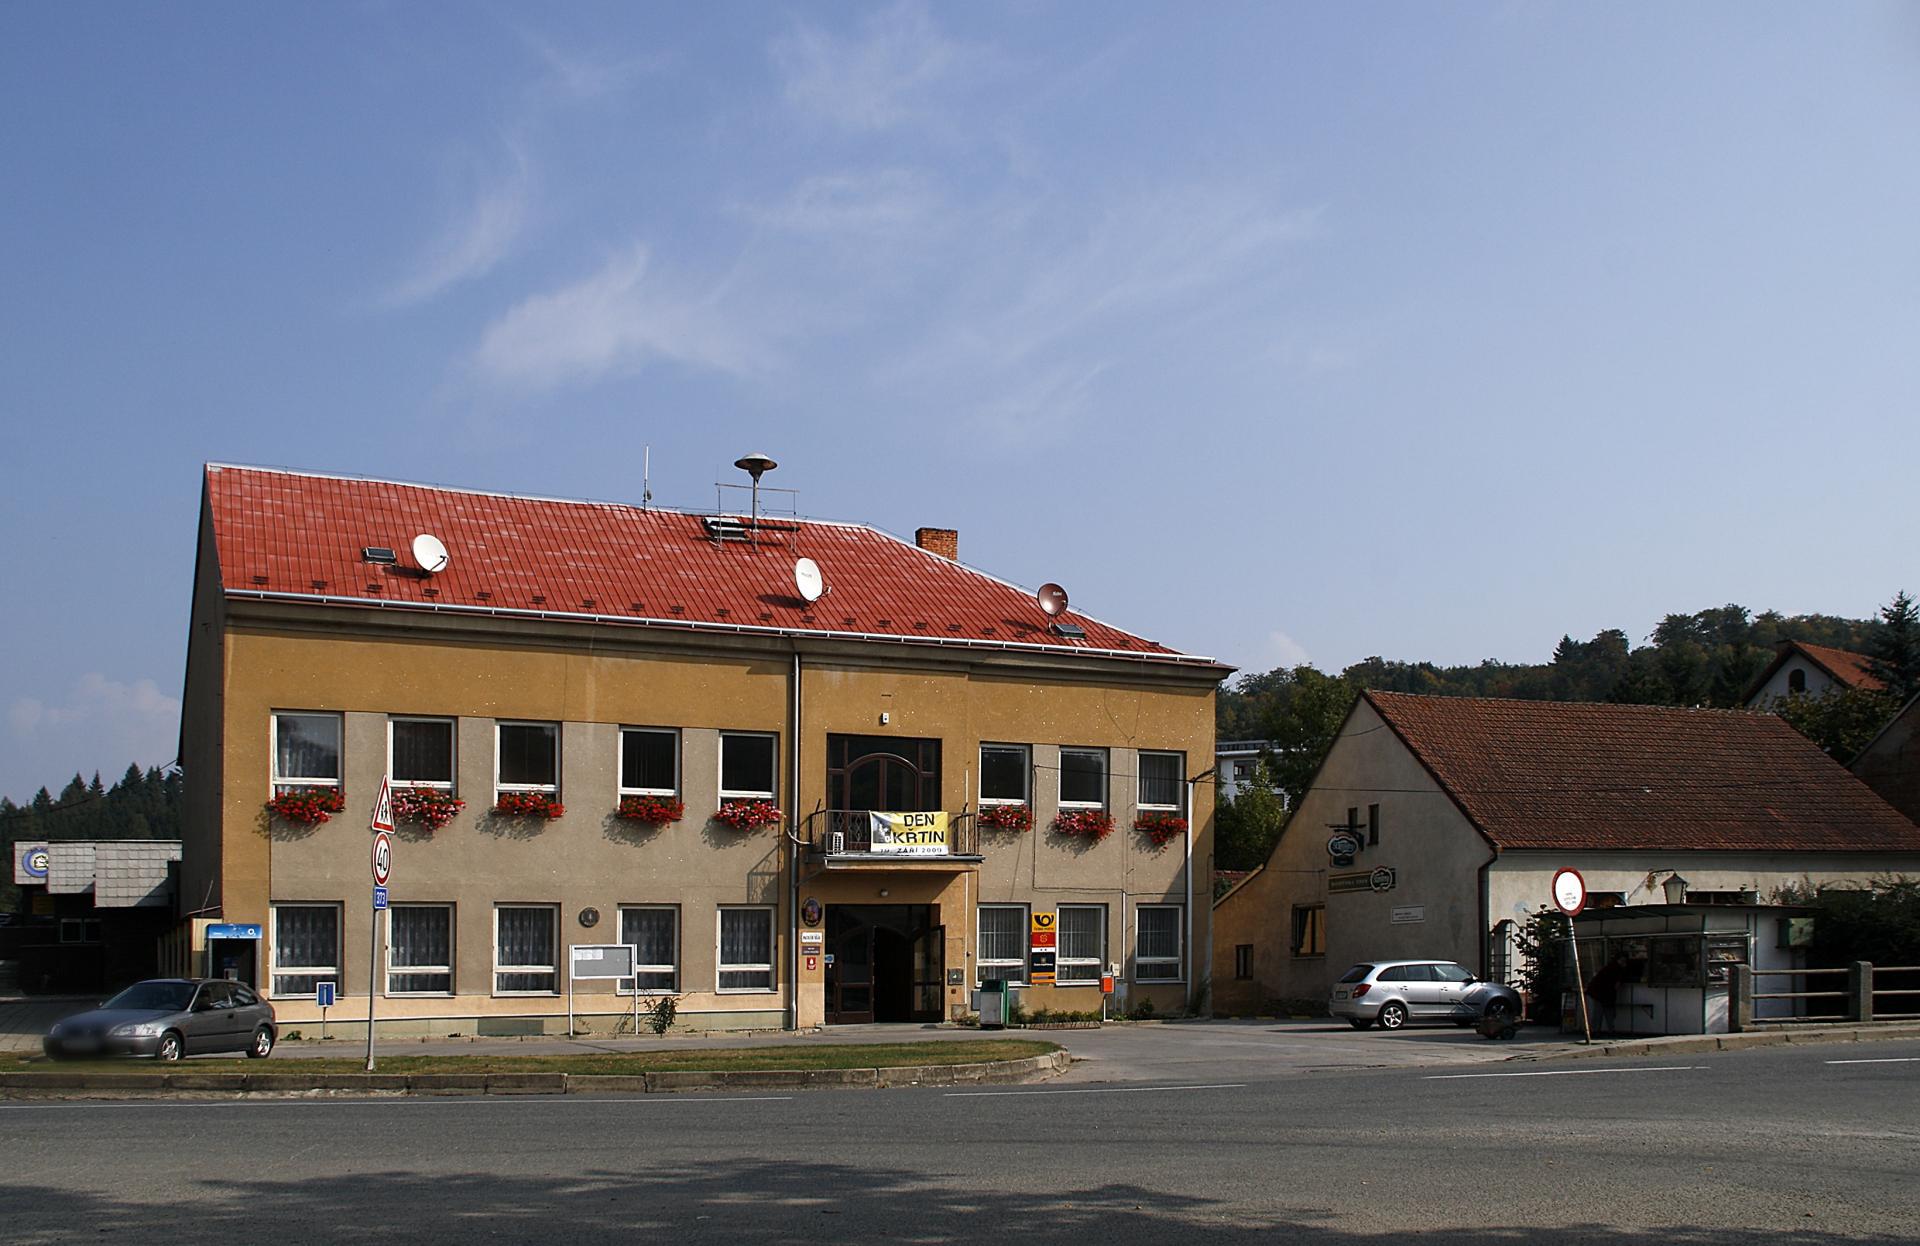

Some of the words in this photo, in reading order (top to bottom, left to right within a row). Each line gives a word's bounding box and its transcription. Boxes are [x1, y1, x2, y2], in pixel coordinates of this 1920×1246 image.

[904, 813, 935, 827] DEN
[893, 827, 945, 844] KŘTIN
[377, 846, 388, 872] 40
